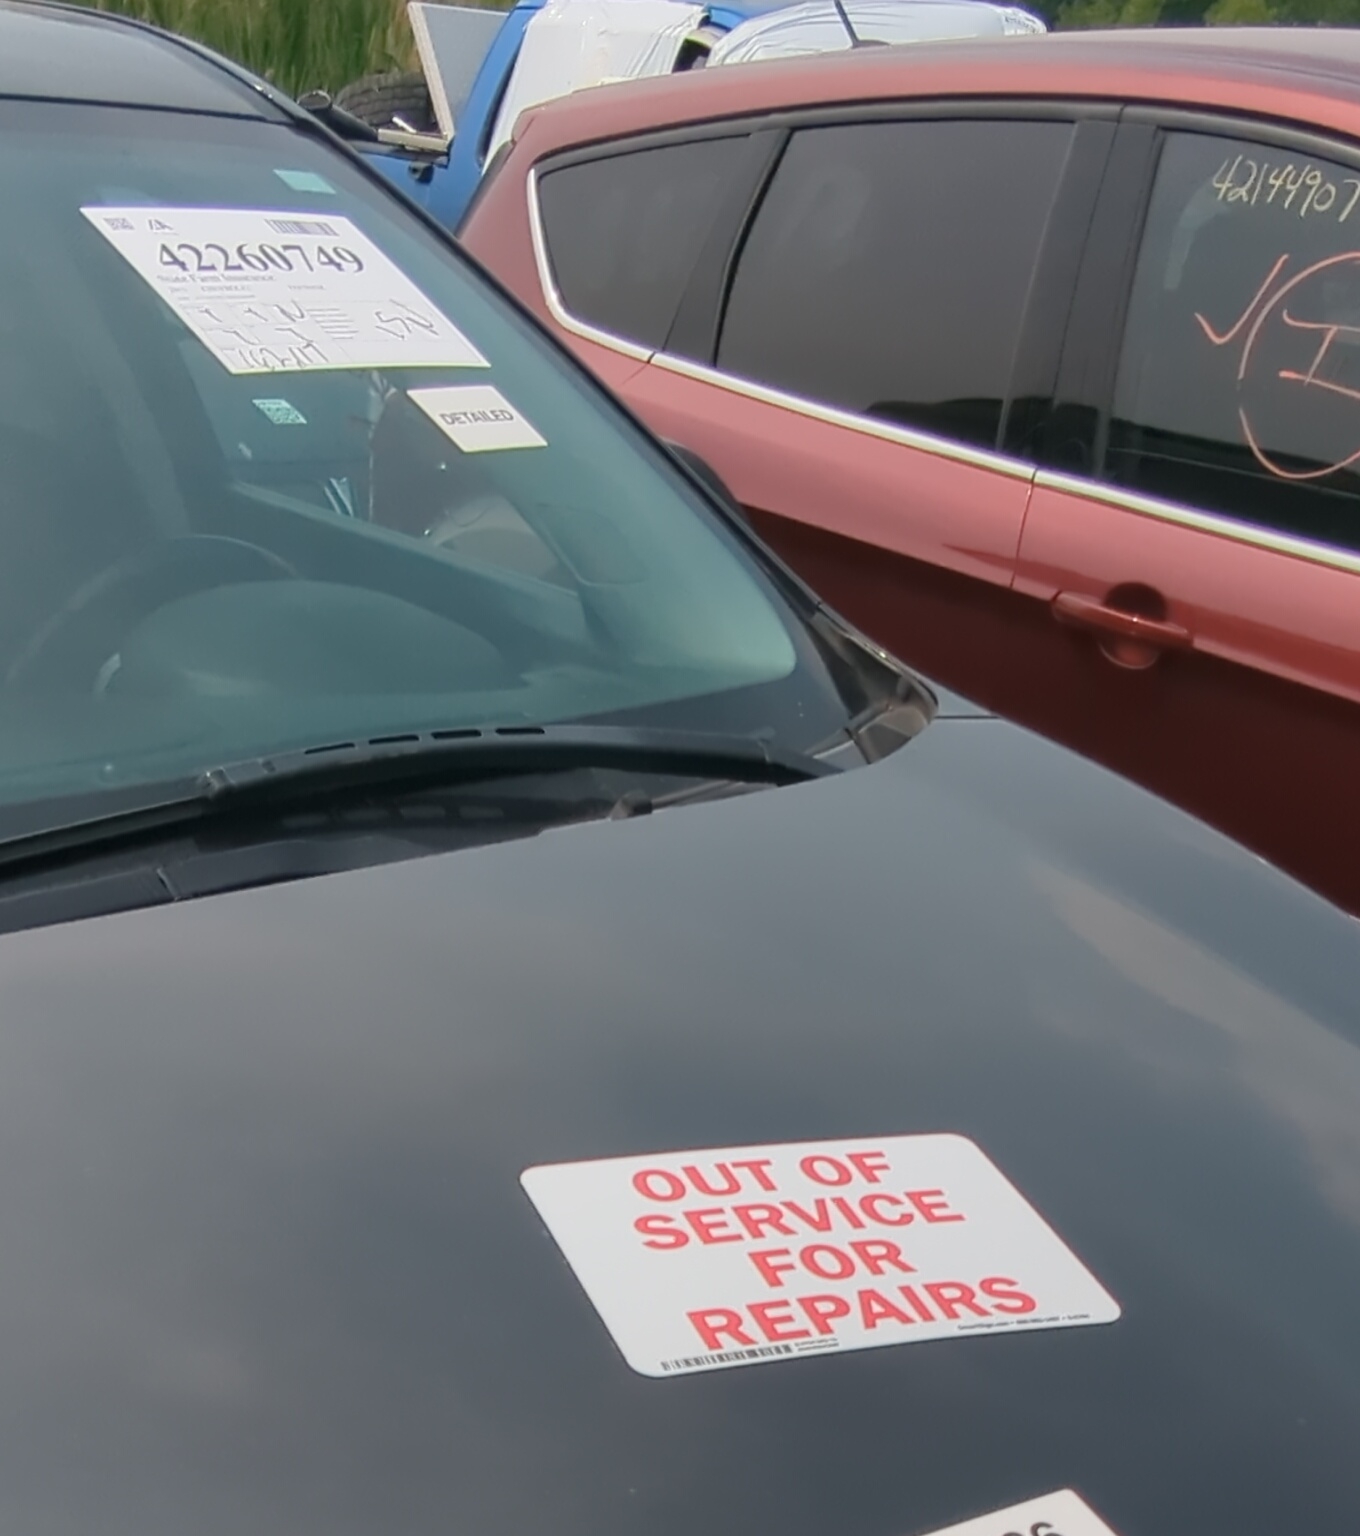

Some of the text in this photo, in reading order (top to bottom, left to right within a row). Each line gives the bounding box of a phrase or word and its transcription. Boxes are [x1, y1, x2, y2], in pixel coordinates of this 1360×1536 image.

[159, 243, 364, 273] 42260749
[439, 409, 515, 425] DETAILED
[631, 1151, 891, 1203] OUT OF
[632, 1189, 966, 1251] SERVICE
[747, 1240, 916, 1288] FOR
[685, 1276, 1038, 1351] REPAIRS
